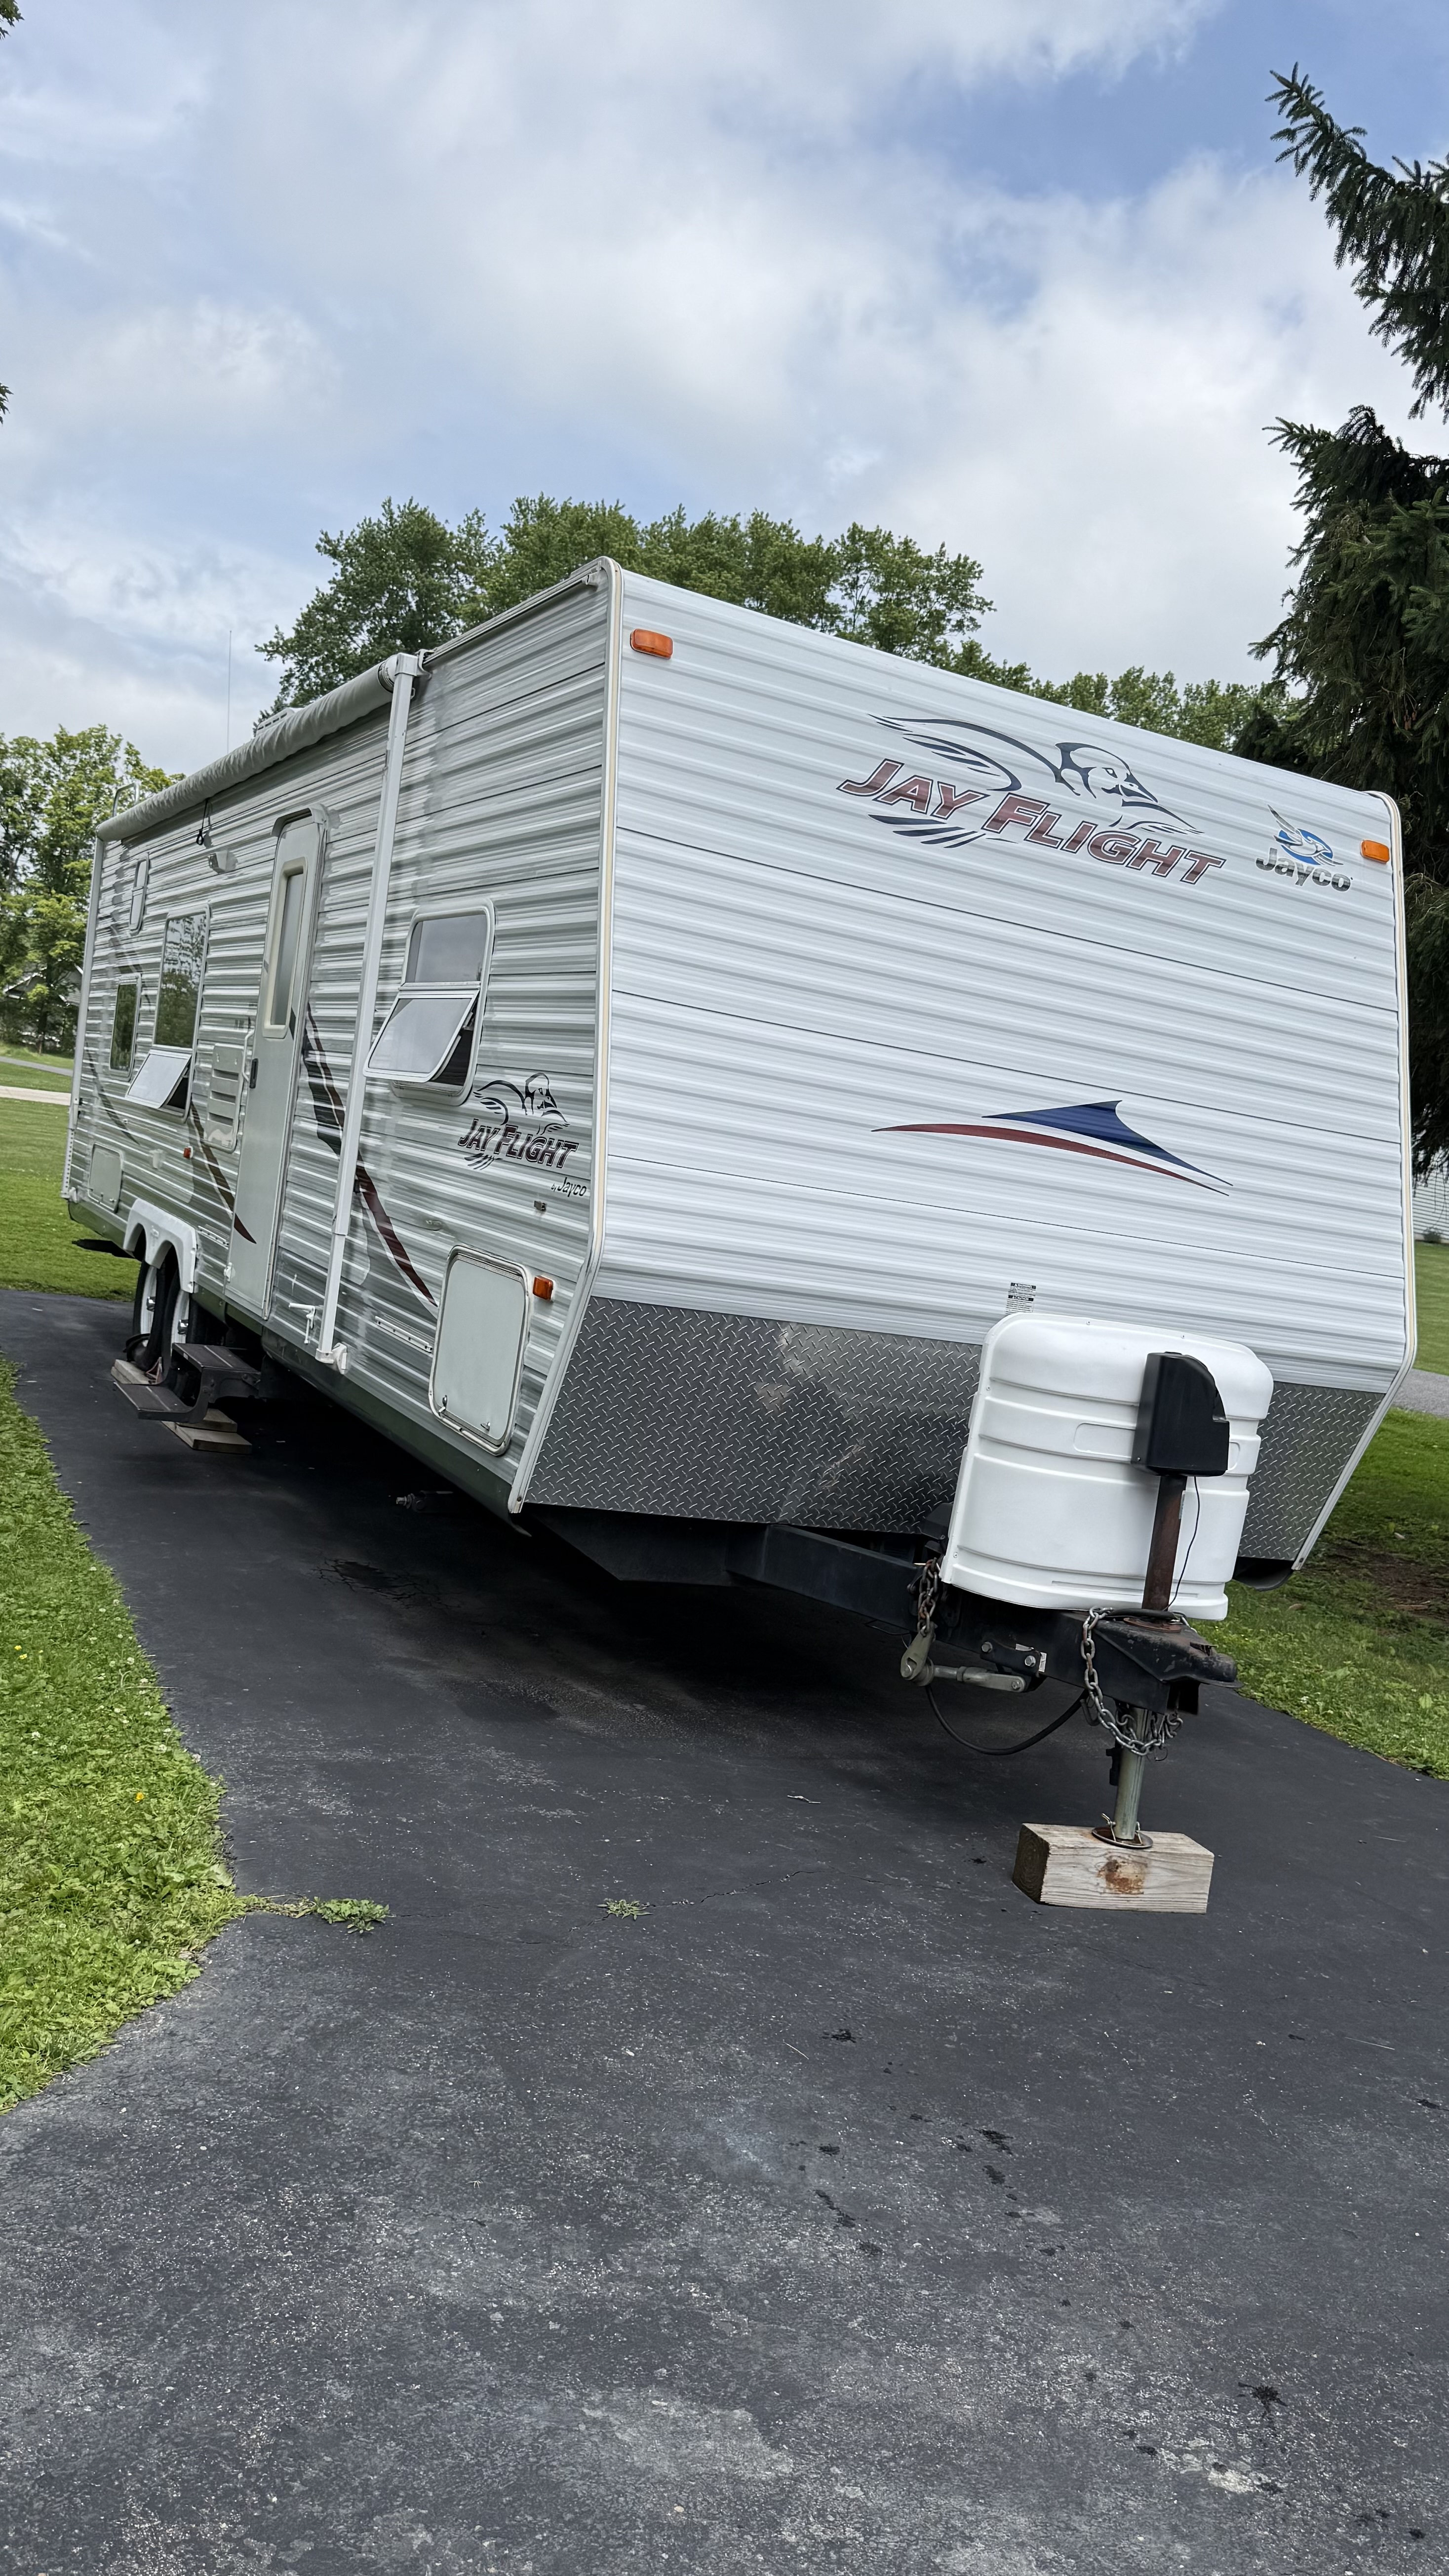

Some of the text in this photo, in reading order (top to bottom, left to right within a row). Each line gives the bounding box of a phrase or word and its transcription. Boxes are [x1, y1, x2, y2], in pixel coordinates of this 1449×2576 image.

[836, 759, 1227, 885] JAY FLIGHT
[1255, 848, 1351, 892] Jayco
[458, 1119, 579, 1169] JAY FLIGHT
[557, 1177, 587, 1197] Jayco
